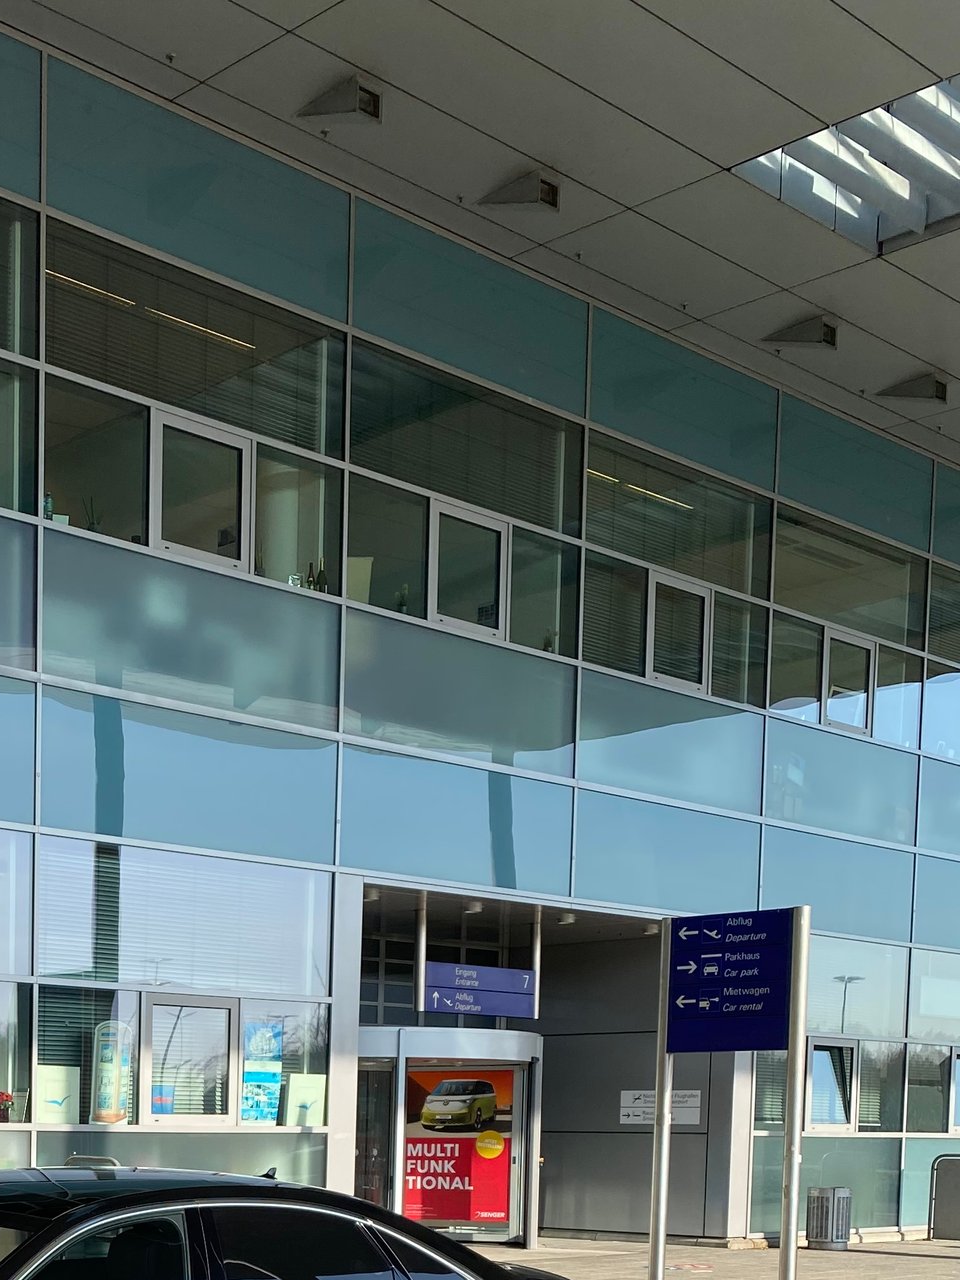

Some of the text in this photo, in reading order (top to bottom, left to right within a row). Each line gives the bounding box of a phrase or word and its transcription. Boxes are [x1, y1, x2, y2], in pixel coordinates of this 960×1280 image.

[726, 917, 753, 927] Abflug
[725, 932, 767, 943] Departure
[724, 952, 760, 961] Parkhaus
[455, 967, 530, 989] Eingang 7
[724, 967, 759, 978] Car park
[455, 978, 480, 987] Entrance
[455, 992, 474, 1003] Abflug
[723, 987, 770, 998] Mietwagen
[455, 1002, 482, 1012] Departure
[722, 1001, 763, 1012] Car rental
[407, 1143, 460, 1157] MULTI
[406, 1160, 456, 1174] FUNK
[405, 1176, 474, 1190] TIONAL
